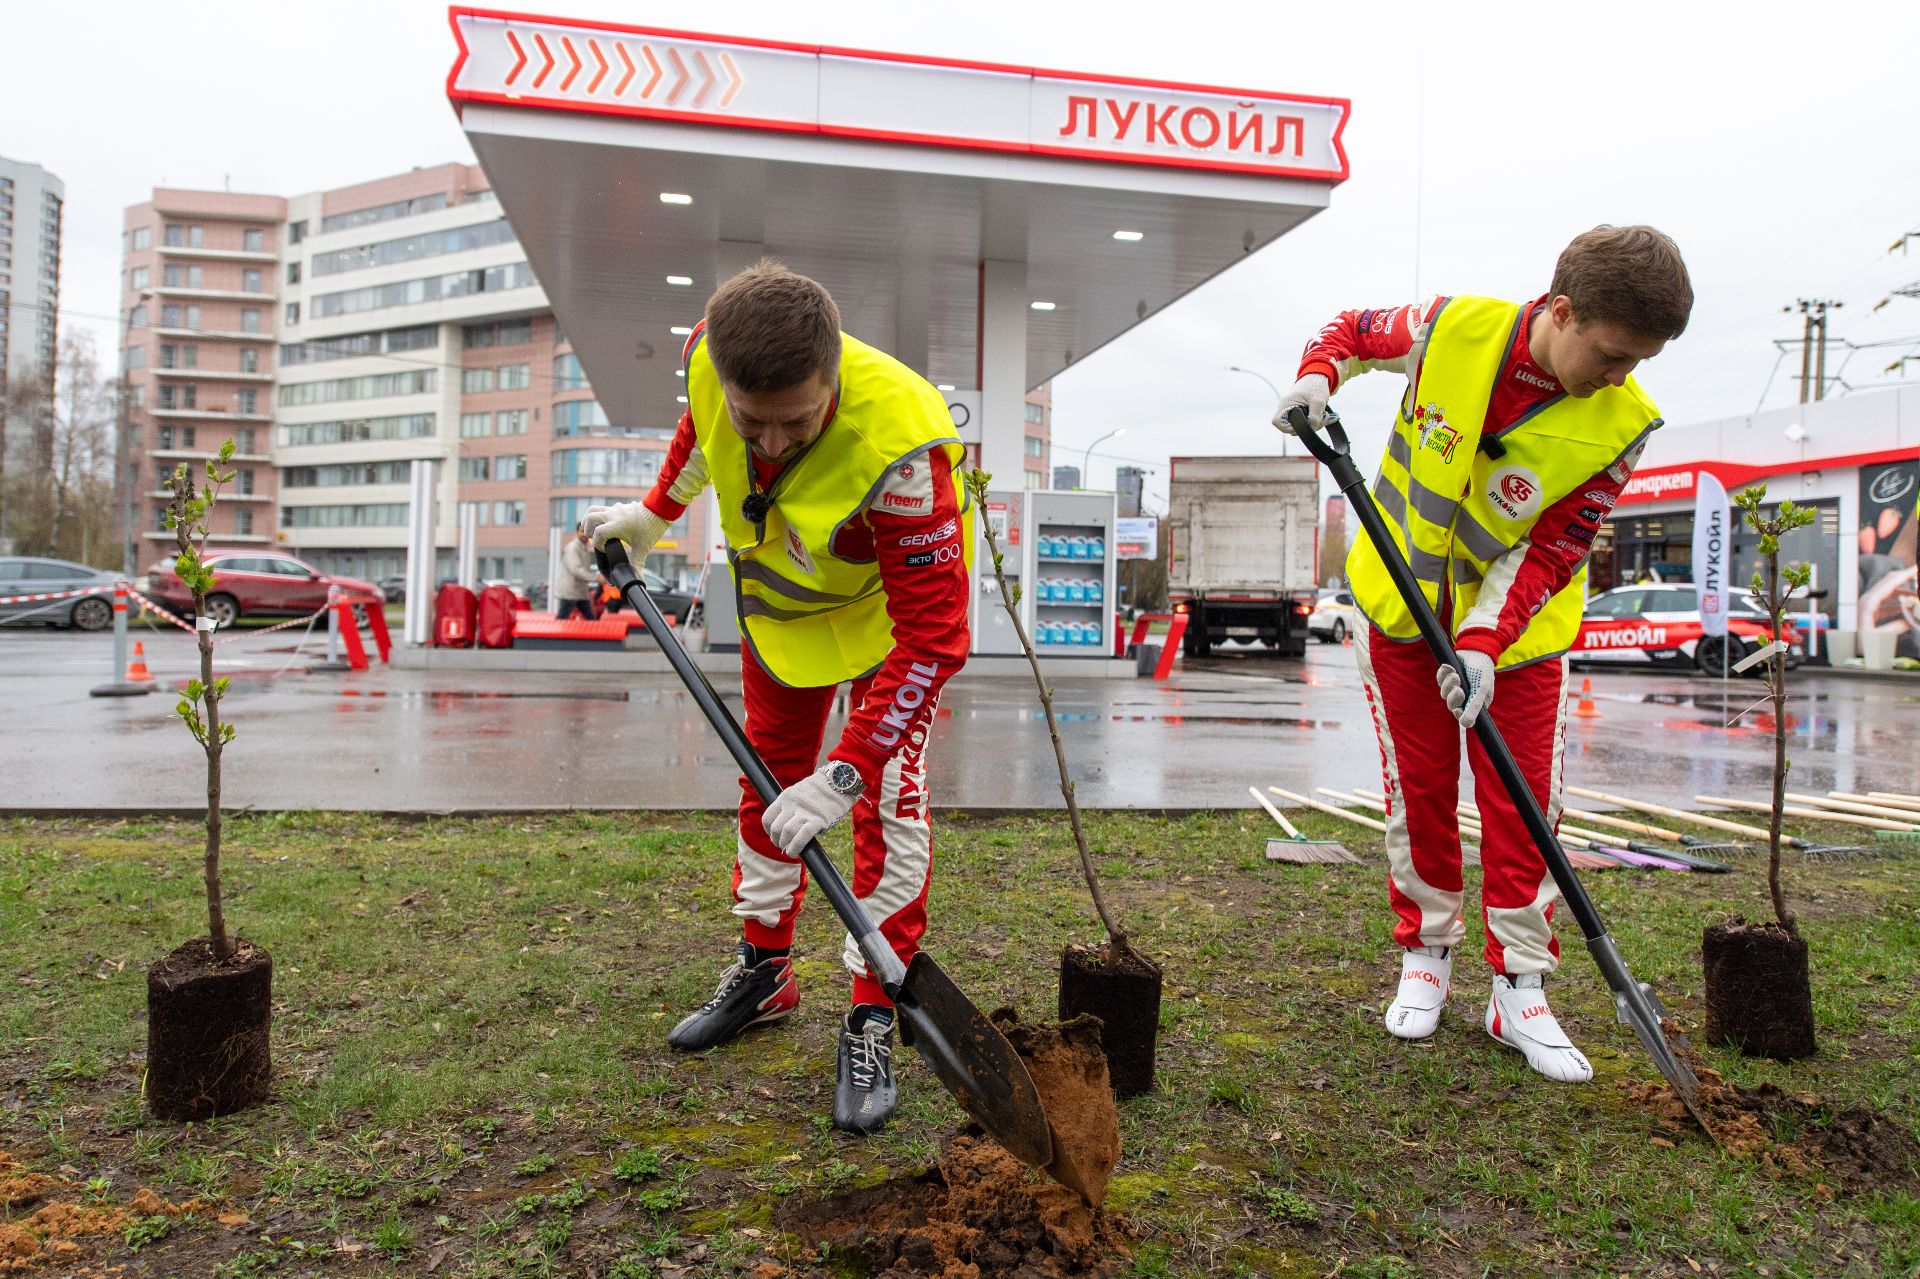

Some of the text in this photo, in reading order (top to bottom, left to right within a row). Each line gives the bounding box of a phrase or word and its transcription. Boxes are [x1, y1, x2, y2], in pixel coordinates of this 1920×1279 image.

[1059, 95, 1304, 156] ЛУКОЙЛ
[1515, 369, 1556, 391] LUKOIL
[883, 491, 925, 509] freem
[1510, 479, 1533, 502] 35
[908, 543, 960, 565] ЭКТО 100
[1706, 510, 1721, 592] ЛУКОЙЛ
[1584, 625, 1666, 649] ЛУКОЙЛ
[1403, 970, 1441, 989] LUKOIL
